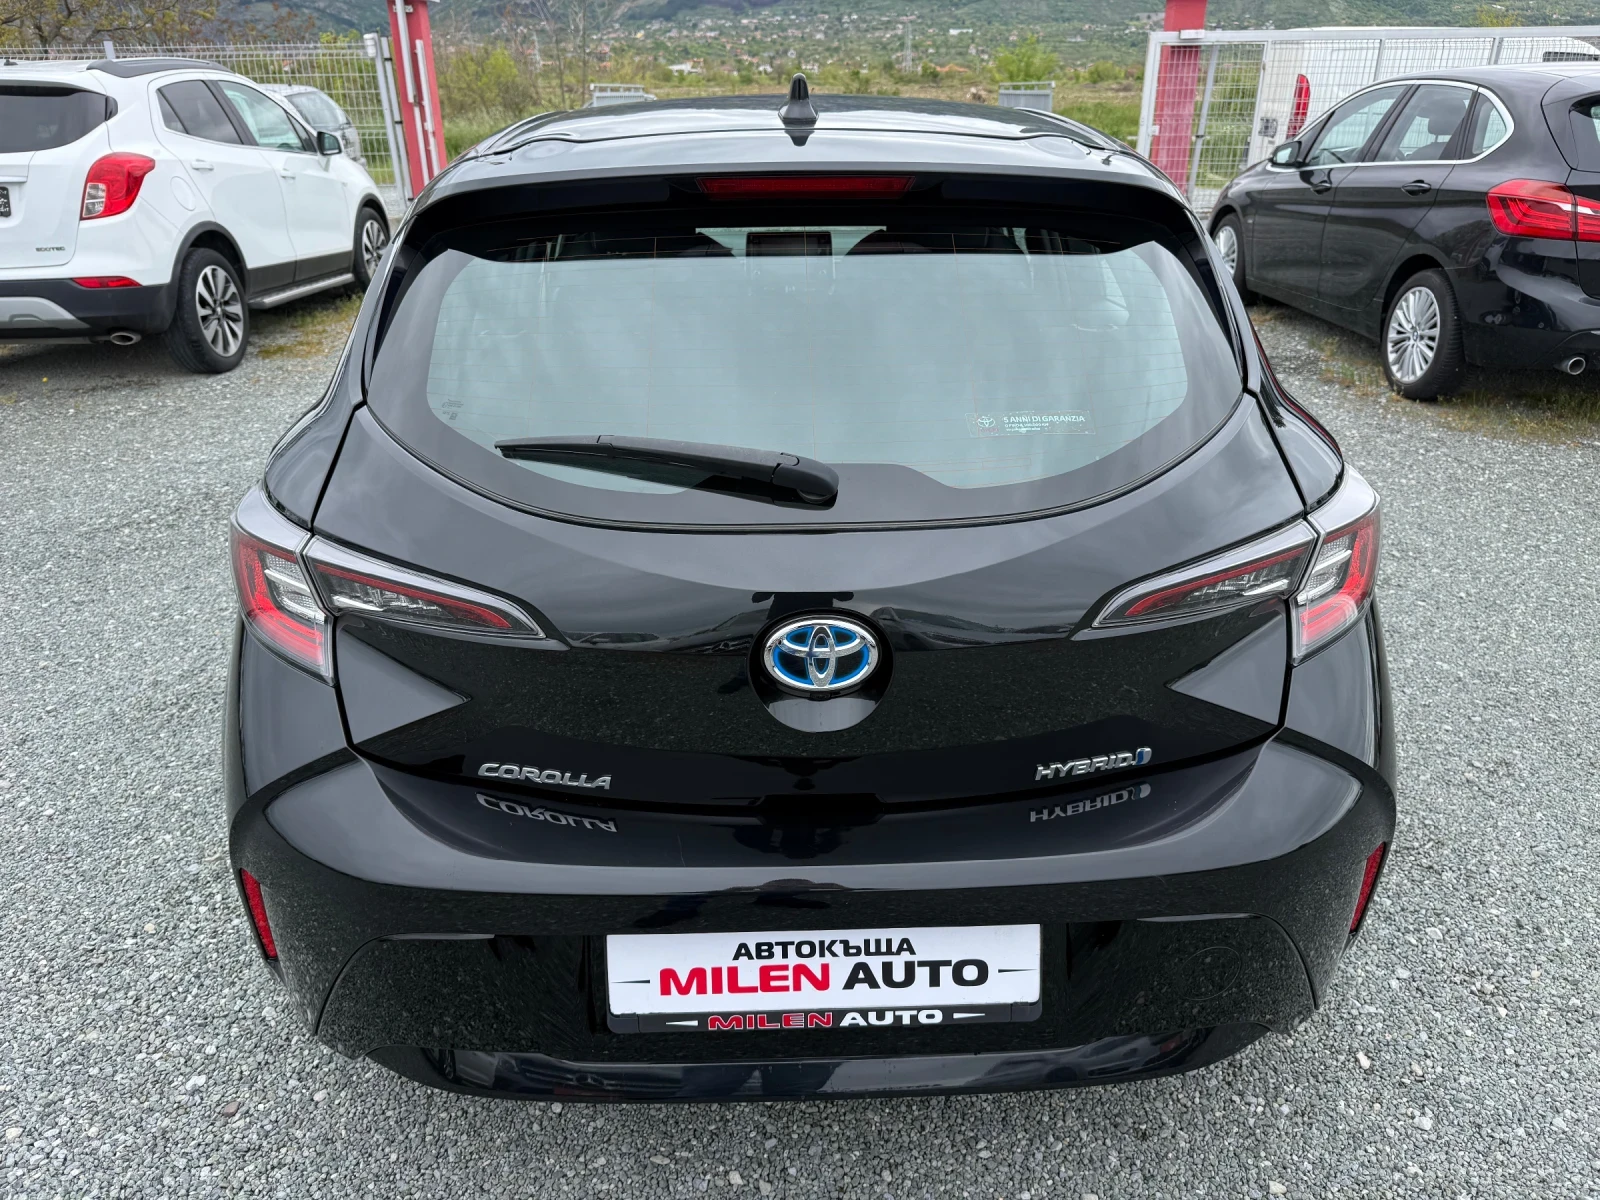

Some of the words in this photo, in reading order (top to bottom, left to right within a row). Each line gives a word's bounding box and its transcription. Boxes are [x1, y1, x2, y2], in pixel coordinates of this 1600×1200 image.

[477, 762, 612, 790] COROLLA
[1035, 751, 1133, 781] HYBRID
[659, 962, 831, 996] MILEN
[842, 958, 989, 990] AUTO
[707, 1011, 834, 1030] MILEN
[839, 1009, 944, 1026] AUTO
